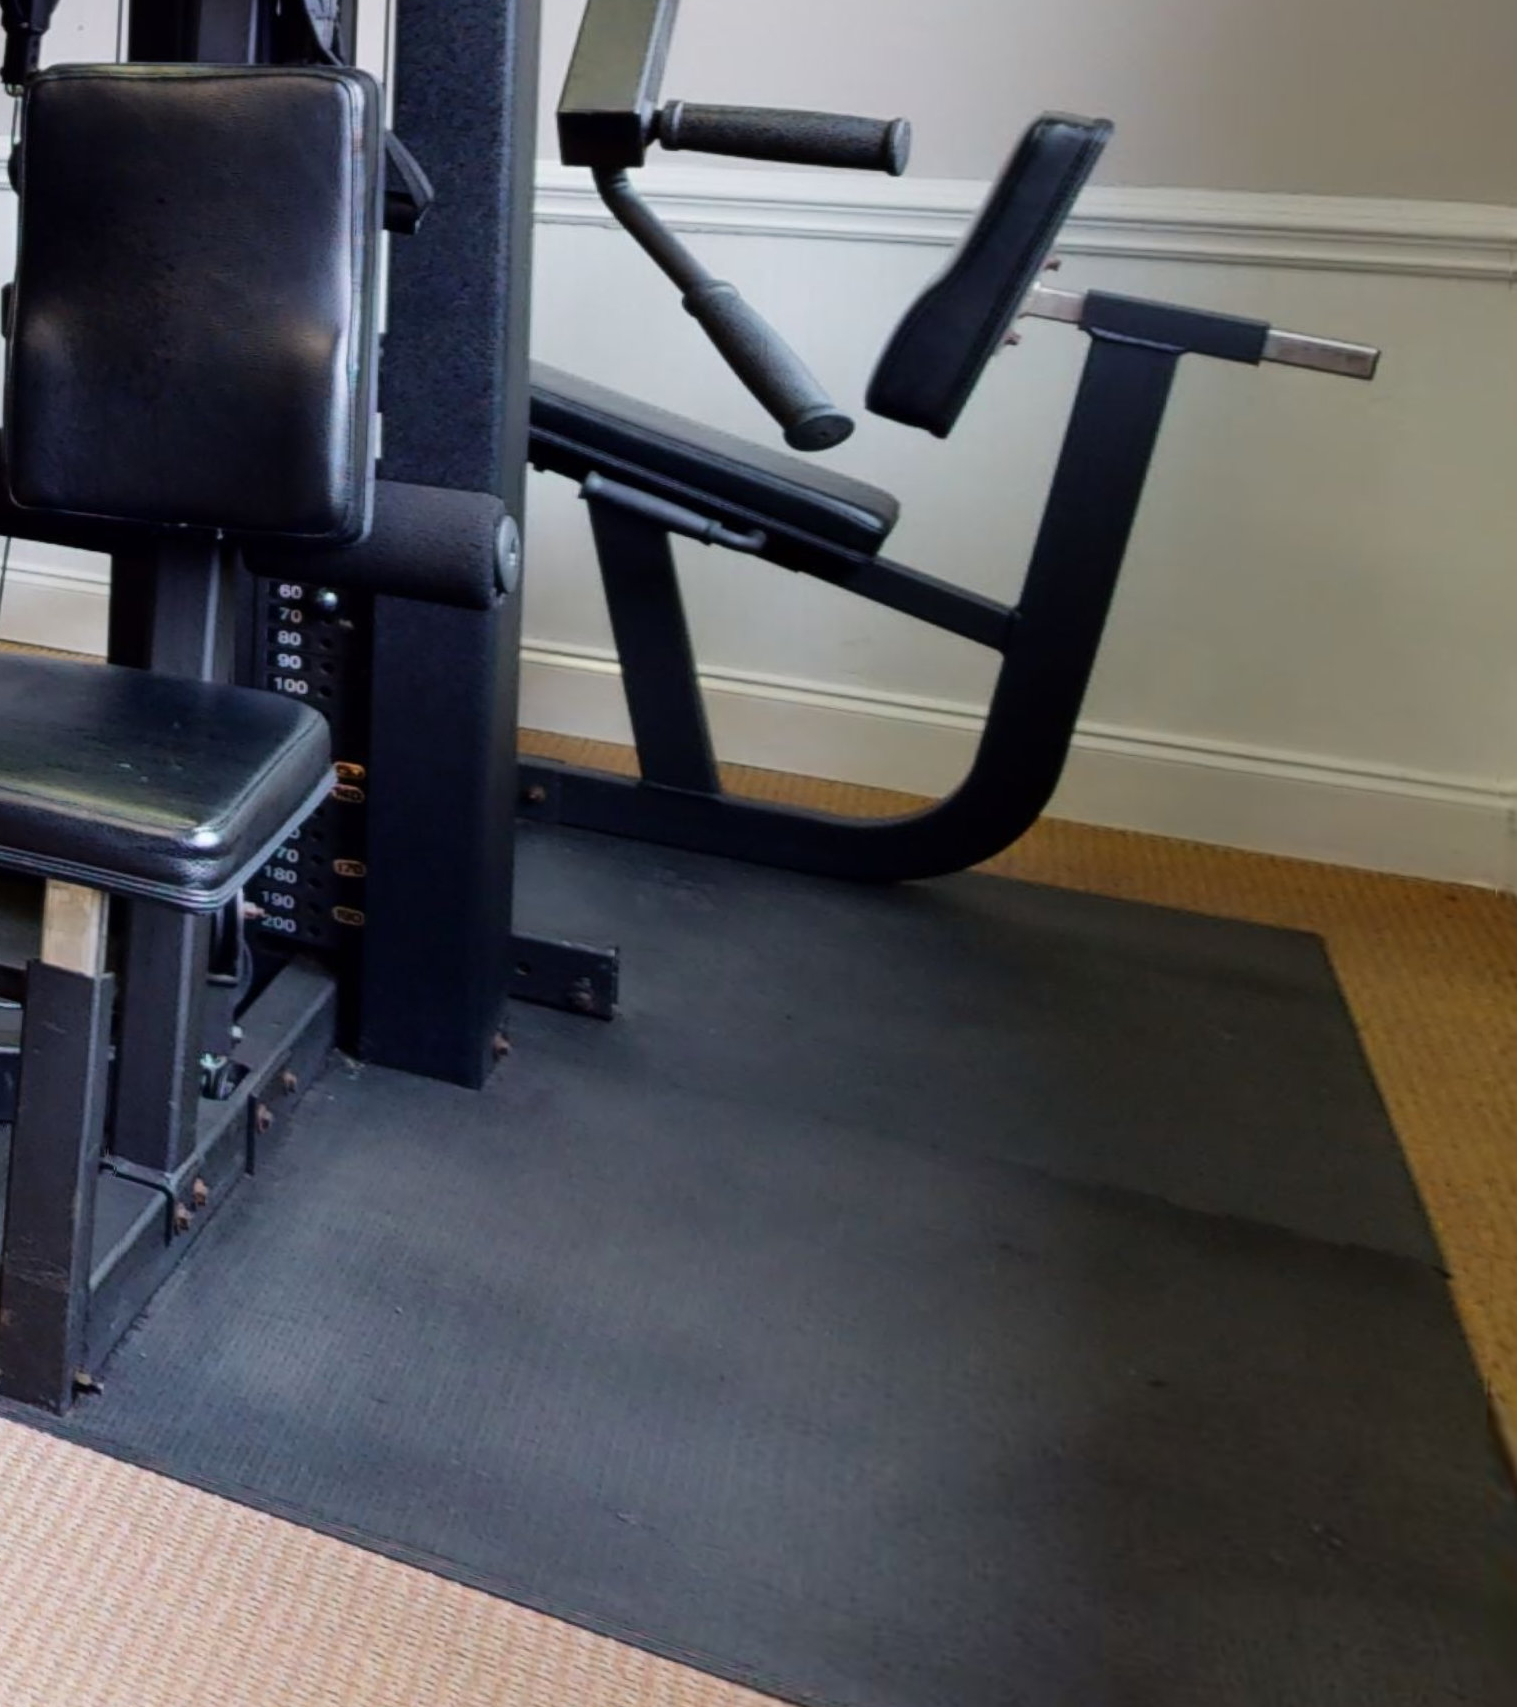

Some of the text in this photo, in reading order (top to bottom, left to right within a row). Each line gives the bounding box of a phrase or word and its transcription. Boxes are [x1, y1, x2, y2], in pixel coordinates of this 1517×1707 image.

[278, 583, 303, 600] 60
[278, 606, 303, 624] 70
[277, 630, 302, 647] 80
[277, 653, 302, 670] 90
[274, 676, 309, 695] 100
[263, 864, 298, 884] 180
[261, 890, 296, 909] 190
[261, 914, 297, 933] 200
